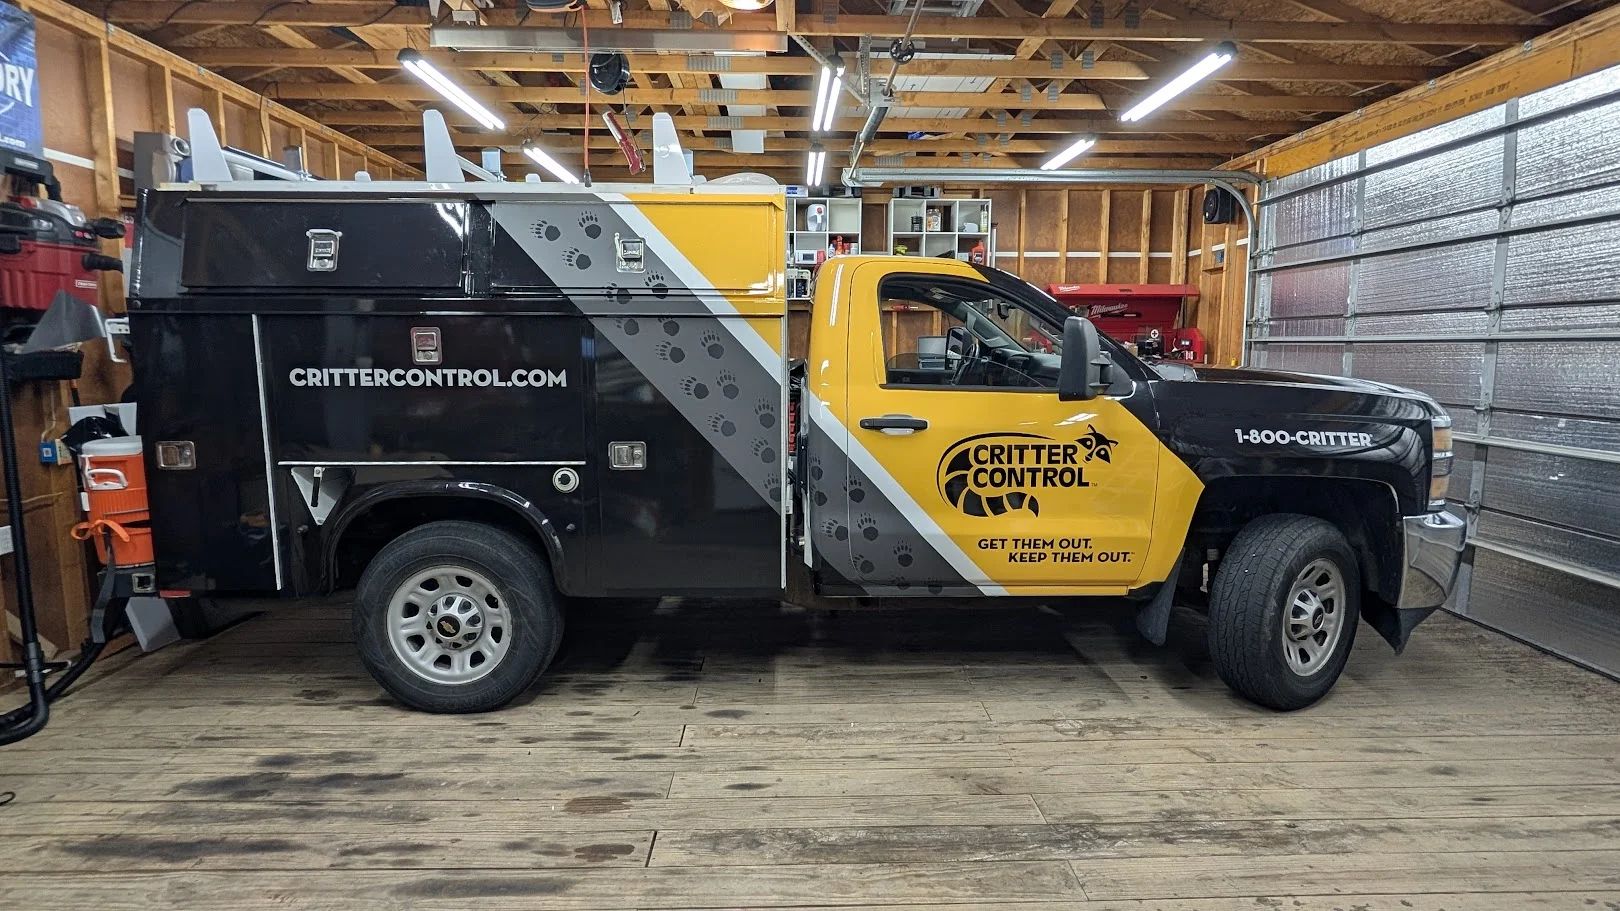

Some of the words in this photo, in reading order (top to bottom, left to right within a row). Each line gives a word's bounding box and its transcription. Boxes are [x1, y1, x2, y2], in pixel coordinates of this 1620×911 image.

[0, 134, 27, 149] .com
[1089, 303, 1128, 317] Milwaukee
[289, 368, 567, 387] CRITTERCONTROL.COM
[1234, 428, 1372, 447] 1-800-CRITTER
[973, 444, 1078, 465] CRITTER
[973, 467, 1090, 488] CONTROL
[978, 538, 1008, 549] GET
[1012, 538, 1054, 549] THEM
[1058, 538, 1092, 549] OUT.
[1008, 552, 1047, 563] KEEP
[1052, 552, 1093, 563] THEM
[1097, 552, 1131, 563] OUT.
